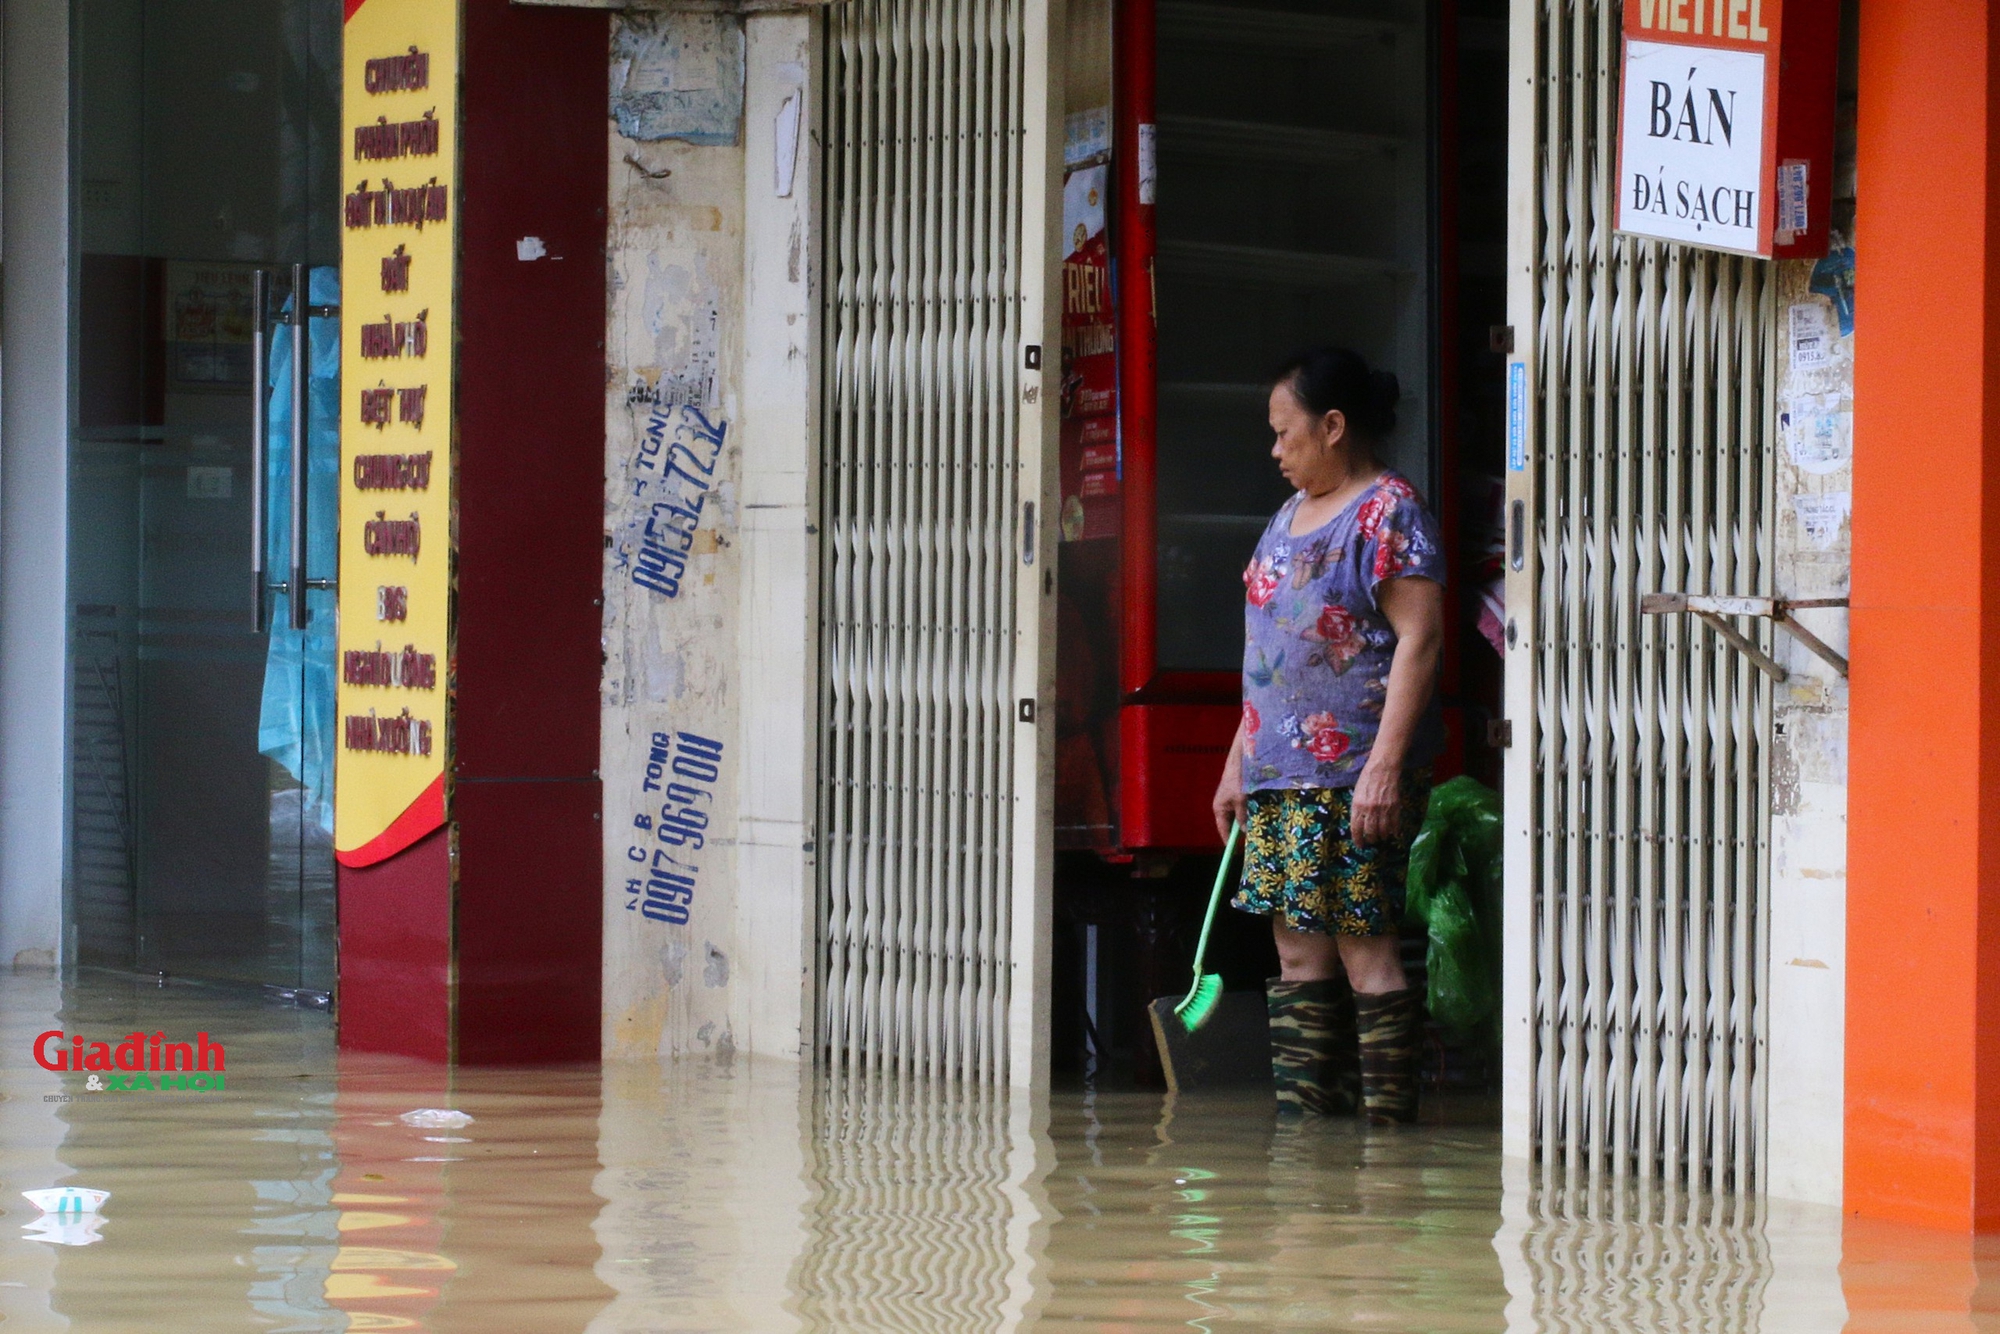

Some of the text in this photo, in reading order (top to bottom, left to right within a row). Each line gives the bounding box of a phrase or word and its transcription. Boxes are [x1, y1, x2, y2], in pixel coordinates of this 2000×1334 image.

[1647, 67, 1737, 148] BÁN
[1633, 165, 1668, 216] ĐÁ
[1676, 180, 1755, 232] SẠCH
